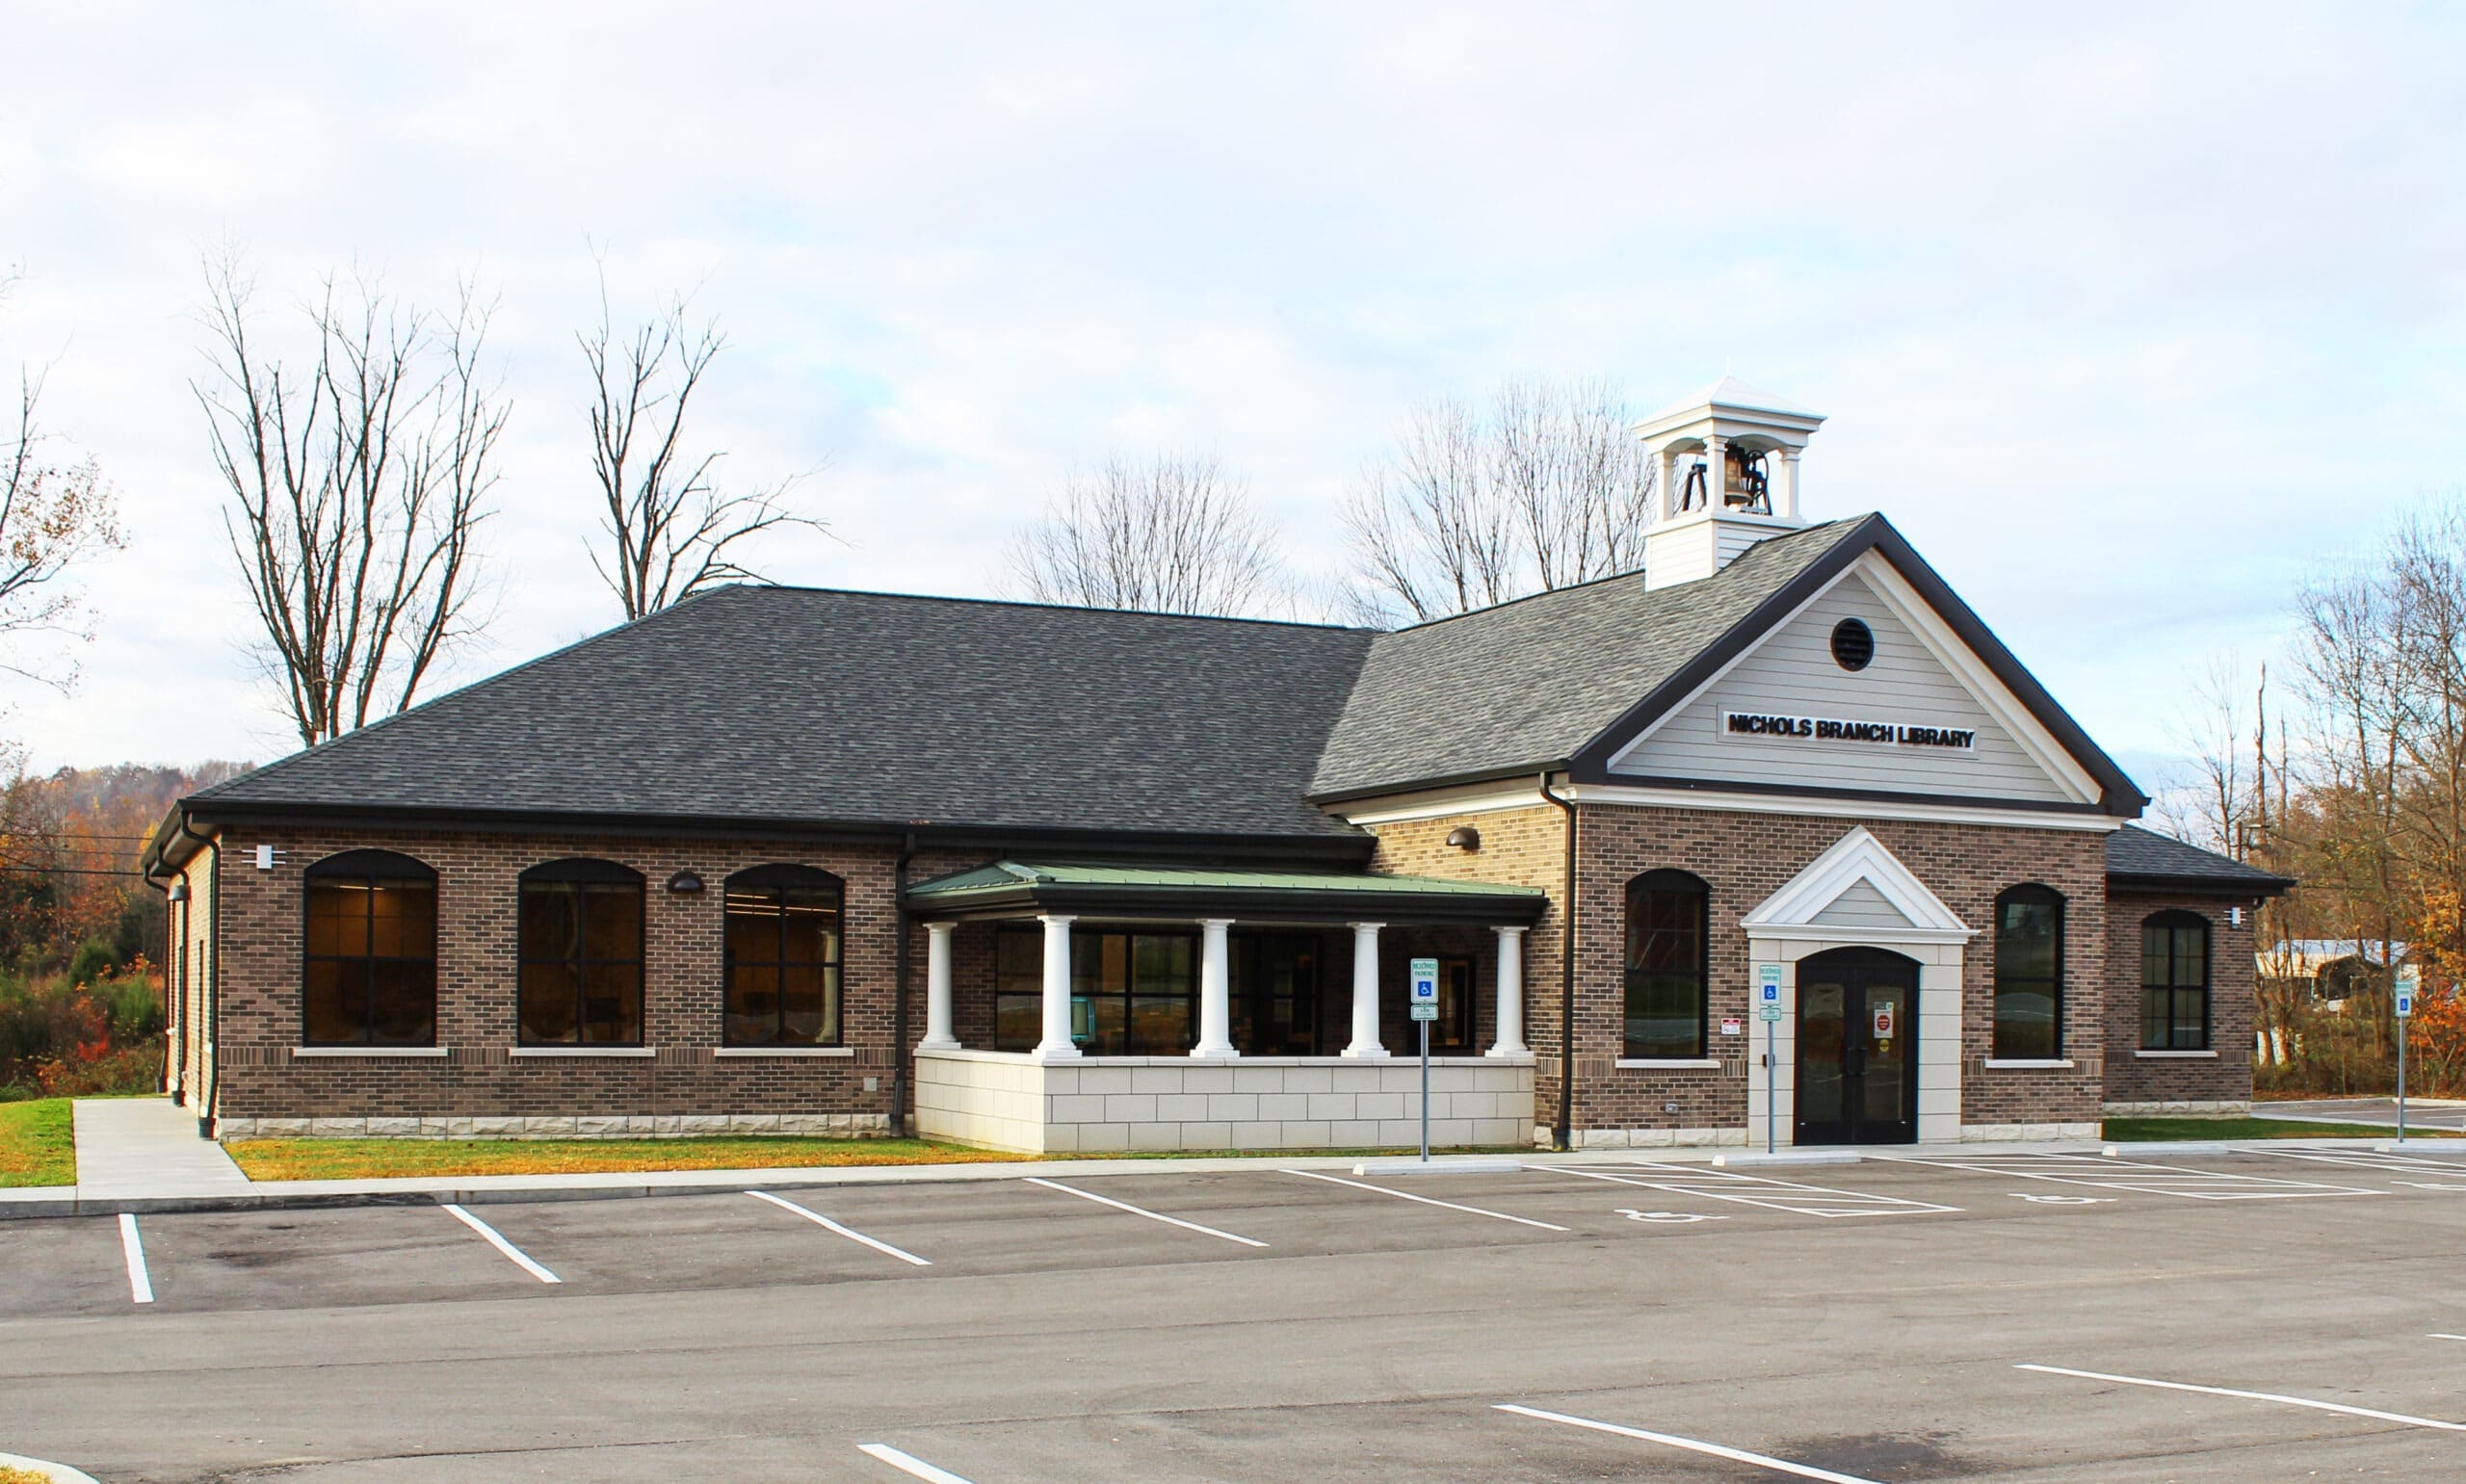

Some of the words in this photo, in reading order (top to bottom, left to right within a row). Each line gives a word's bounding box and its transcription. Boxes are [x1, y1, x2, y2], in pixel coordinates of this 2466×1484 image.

[1728, 714, 1812, 737] NICHOLS
[1816, 720, 1894, 742] BRANCH
[1898, 726, 1975, 748] LIBRARY
